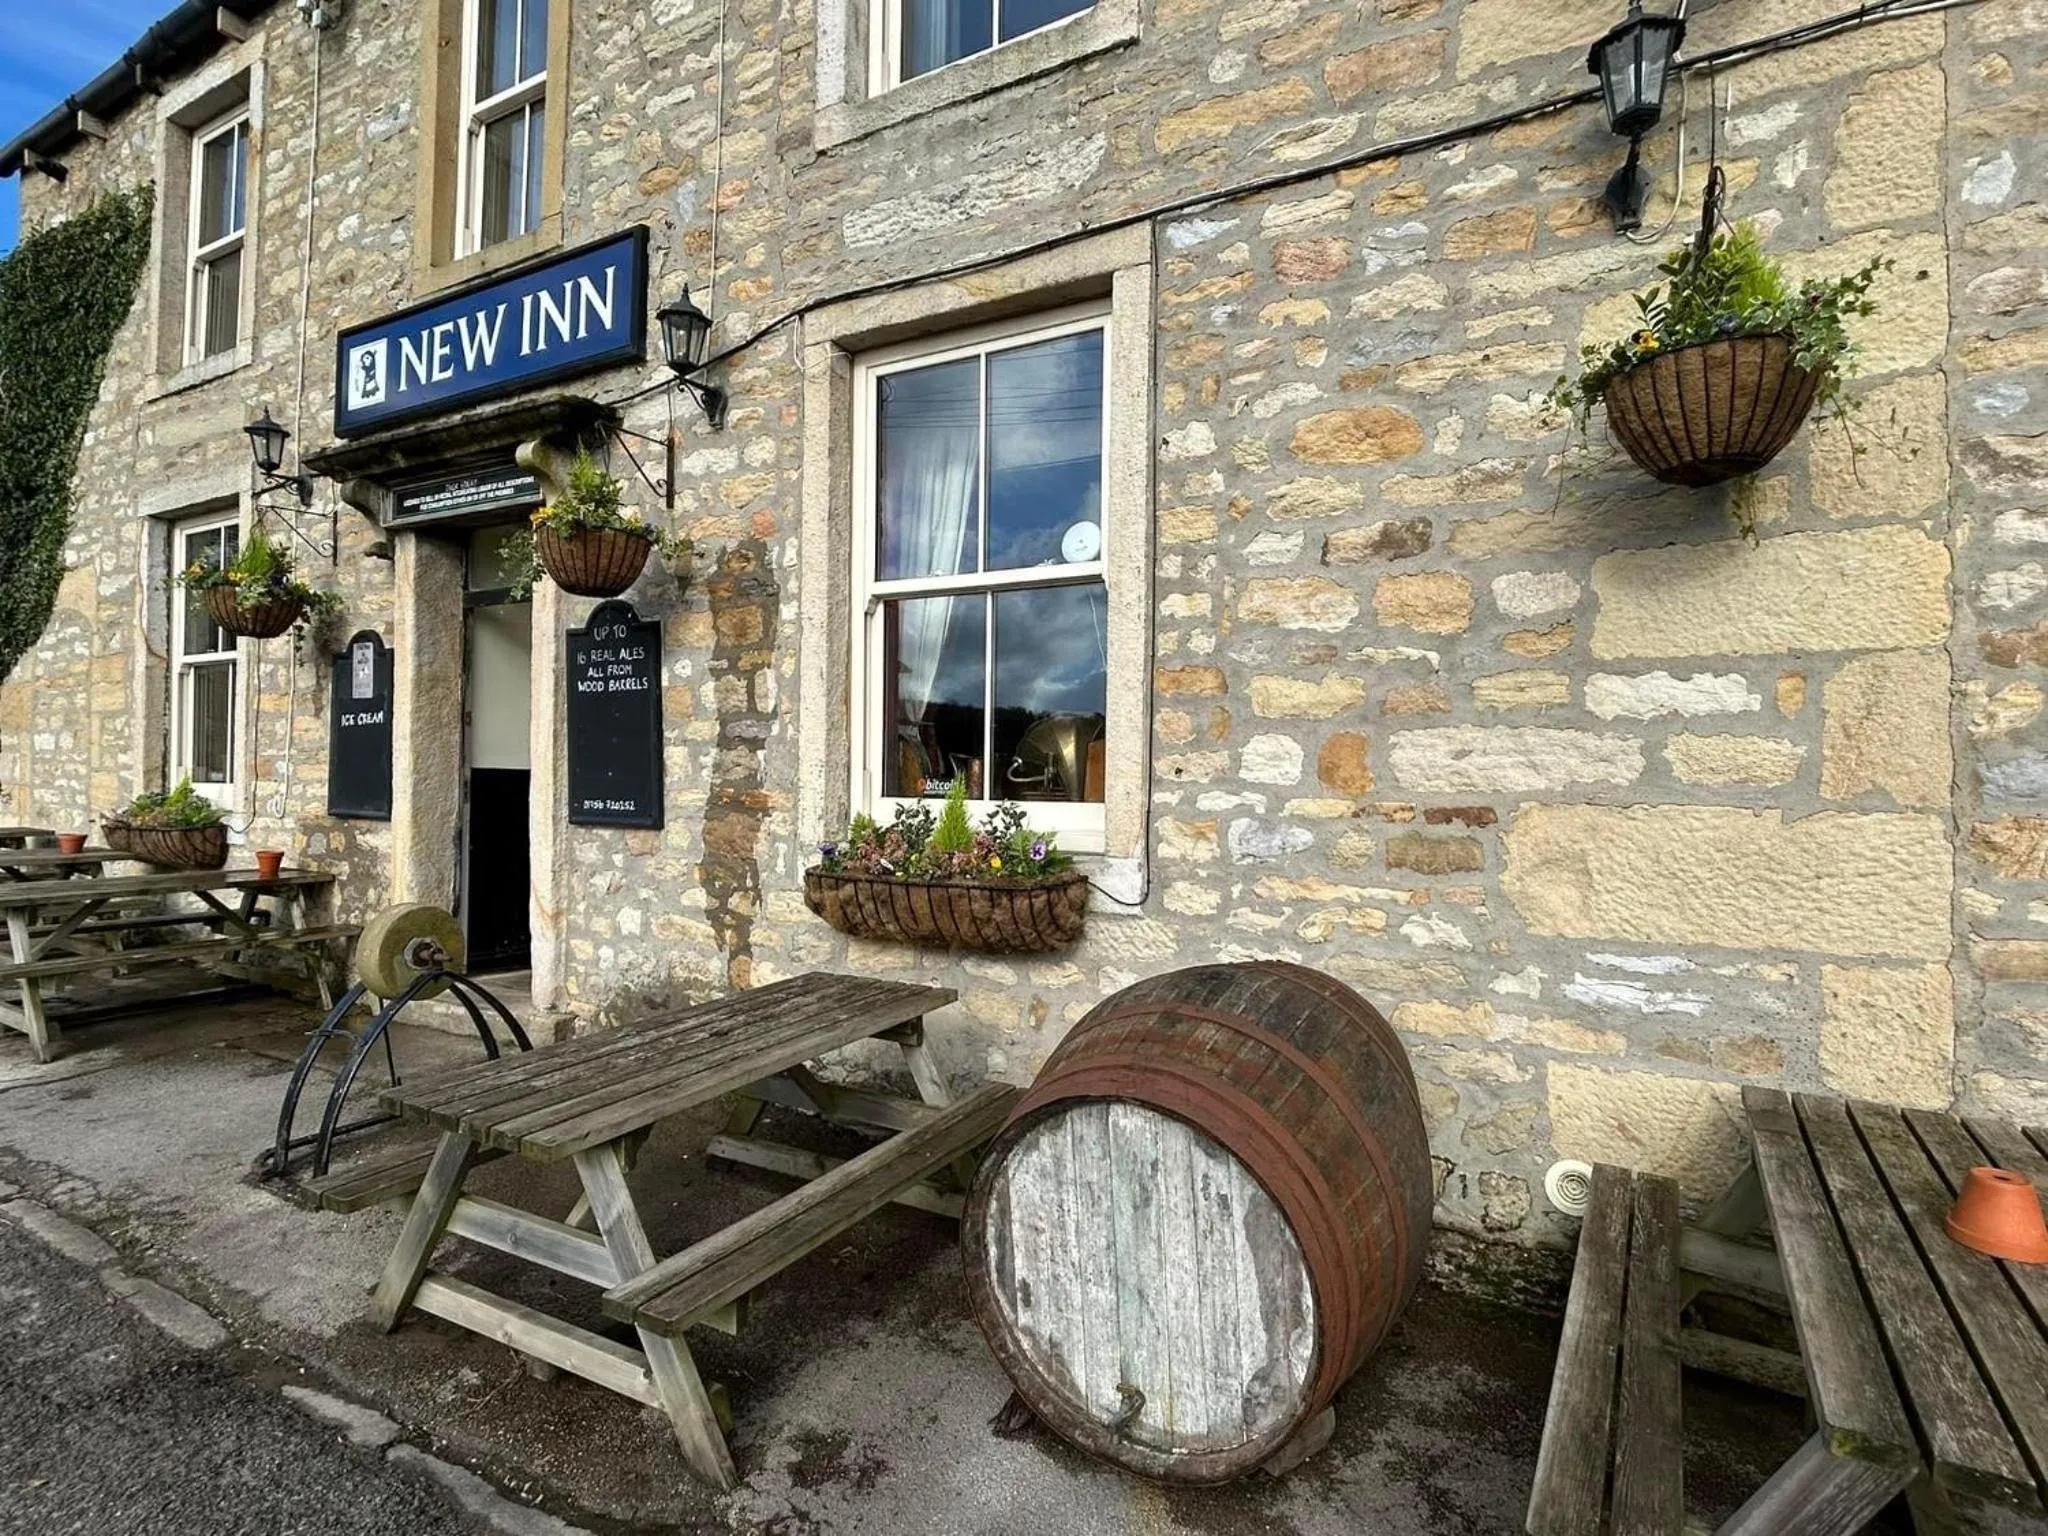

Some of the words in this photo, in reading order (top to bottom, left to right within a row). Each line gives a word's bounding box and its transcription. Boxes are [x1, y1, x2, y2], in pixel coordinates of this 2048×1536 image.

[398, 303, 507, 392] NEW
[520, 266, 616, 356] INN
[593, 626, 609, 641] UP
[613, 624, 627, 639] TO
[590, 649, 615, 662] REAL
[619, 646, 645, 661] ALES
[587, 667, 604, 677] ALL
[607, 664, 632, 676] FROM
[577, 680, 604, 692] WOOD
[608, 677, 648, 692] BARRELS
[340, 713, 355, 727] ICE
[357, 710, 384, 726] CREAM
[925, 778, 955, 790] bitcoi
